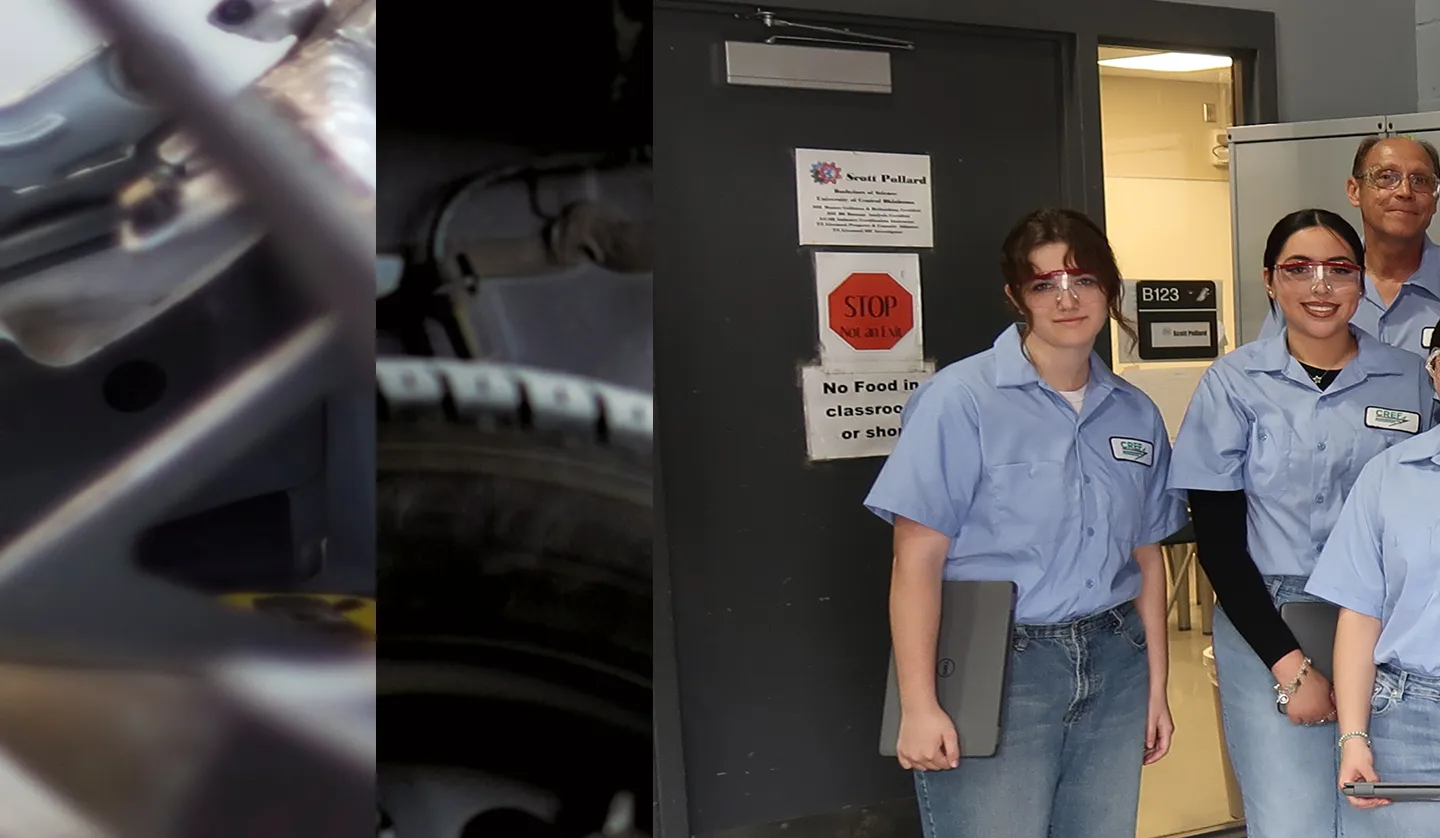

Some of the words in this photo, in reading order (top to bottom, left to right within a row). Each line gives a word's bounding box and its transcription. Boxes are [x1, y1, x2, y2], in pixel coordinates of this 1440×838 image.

[846, 173, 877, 183] Scott
[881, 174, 927, 184] Pollard
[1142, 287, 1180, 302] B123
[844, 295, 897, 318] STOP
[823, 381, 849, 394] No
[854, 380, 898, 393] Food
[904, 379, 919, 391] in
[826, 404, 903, 418] classroo
[1375, 409, 1403, 420] CREF
[841, 429, 860, 440] or
